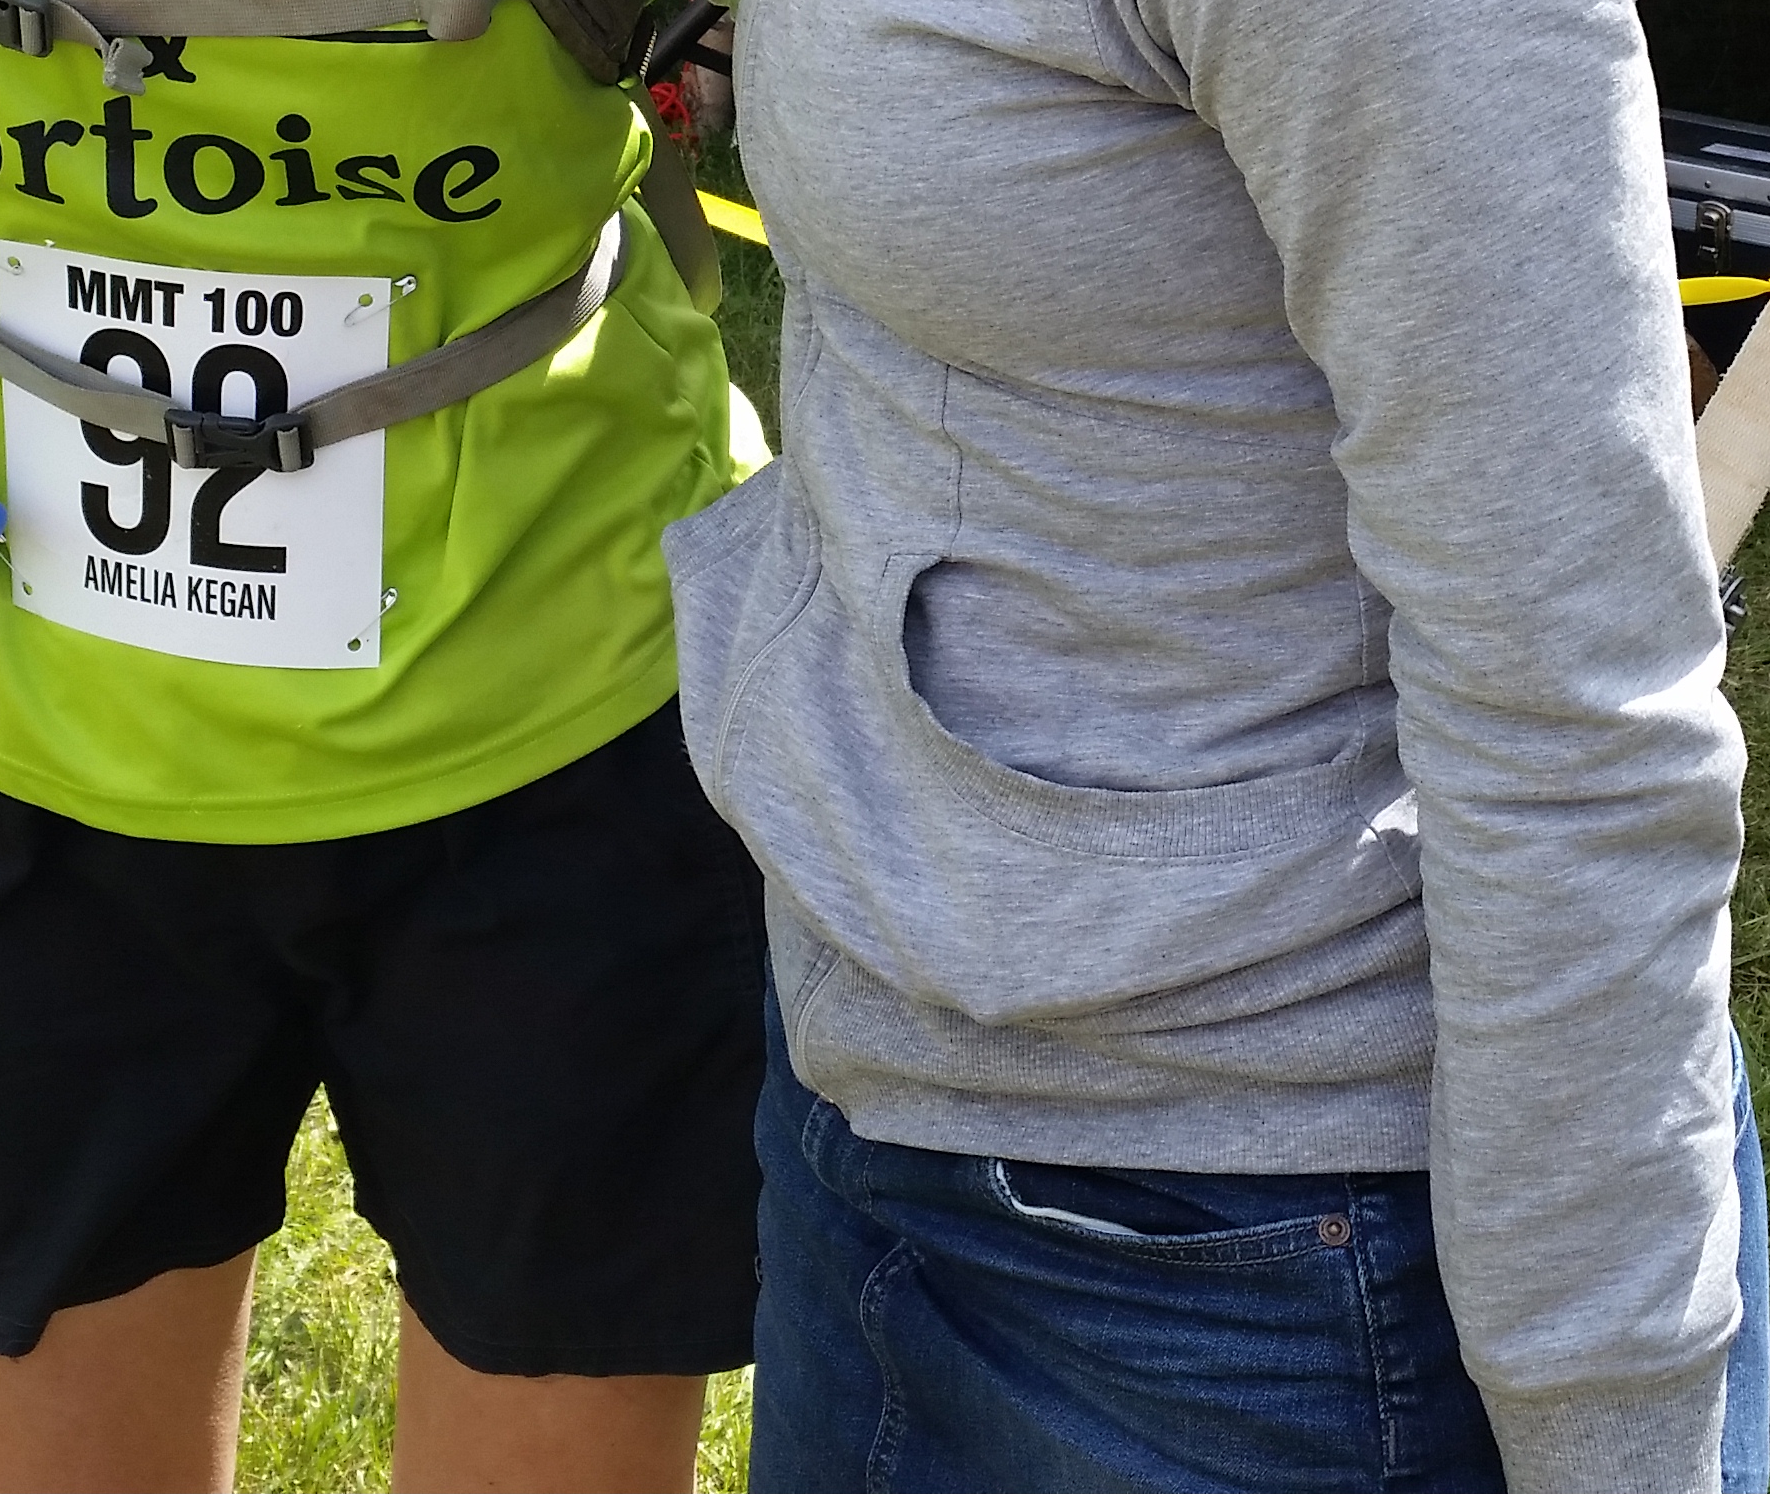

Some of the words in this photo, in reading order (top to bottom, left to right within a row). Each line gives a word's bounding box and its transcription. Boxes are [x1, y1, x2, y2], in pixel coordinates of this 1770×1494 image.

[65, 264, 185, 329] MMT
[202, 287, 304, 338] 100
[79, 327, 289, 575] 92
[84, 554, 178, 609] AMELIA
[186, 574, 277, 622] KEGAN
